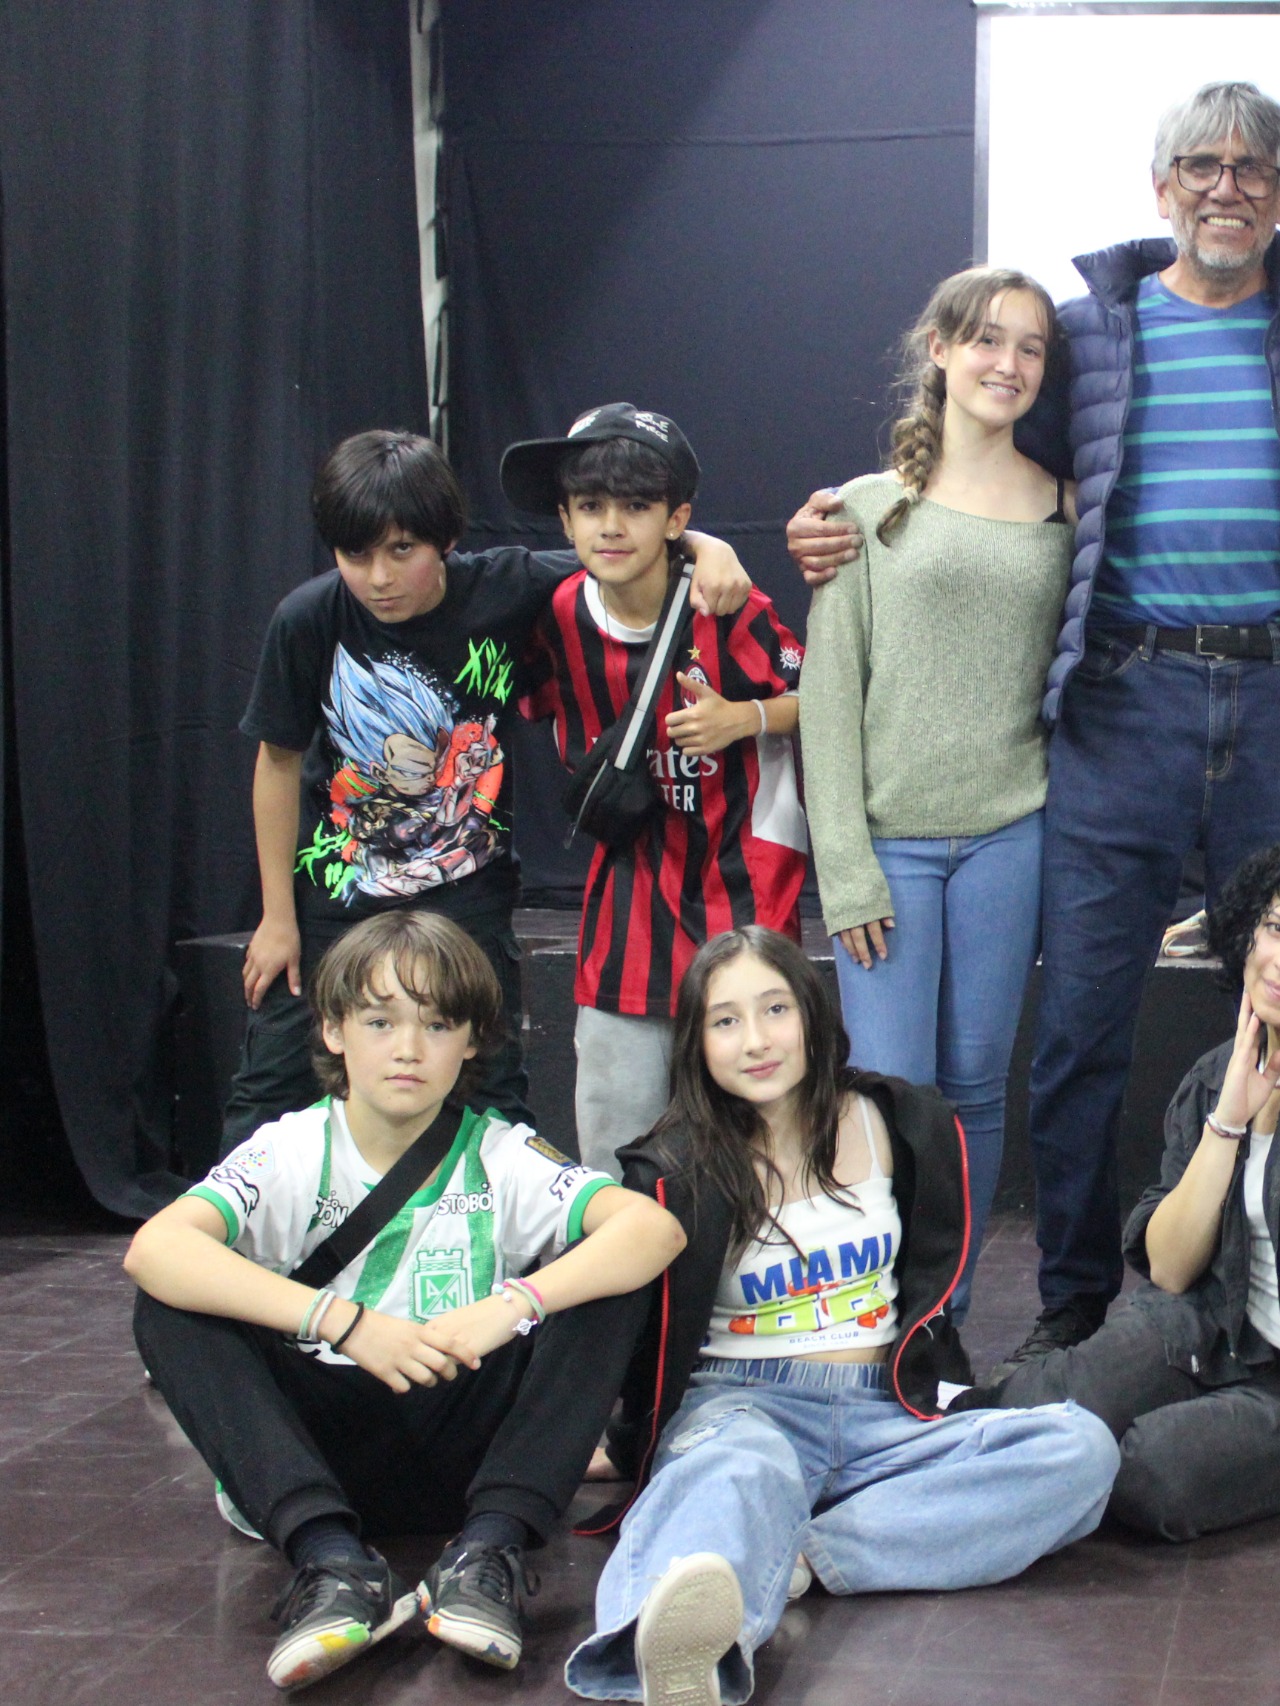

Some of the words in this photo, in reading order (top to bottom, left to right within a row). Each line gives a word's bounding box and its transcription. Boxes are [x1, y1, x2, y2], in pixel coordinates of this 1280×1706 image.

[739, 1232, 893, 1305] MIAMI
[789, 1334, 826, 1344] BEACH
[830, 1330, 859, 1340] CLUB
